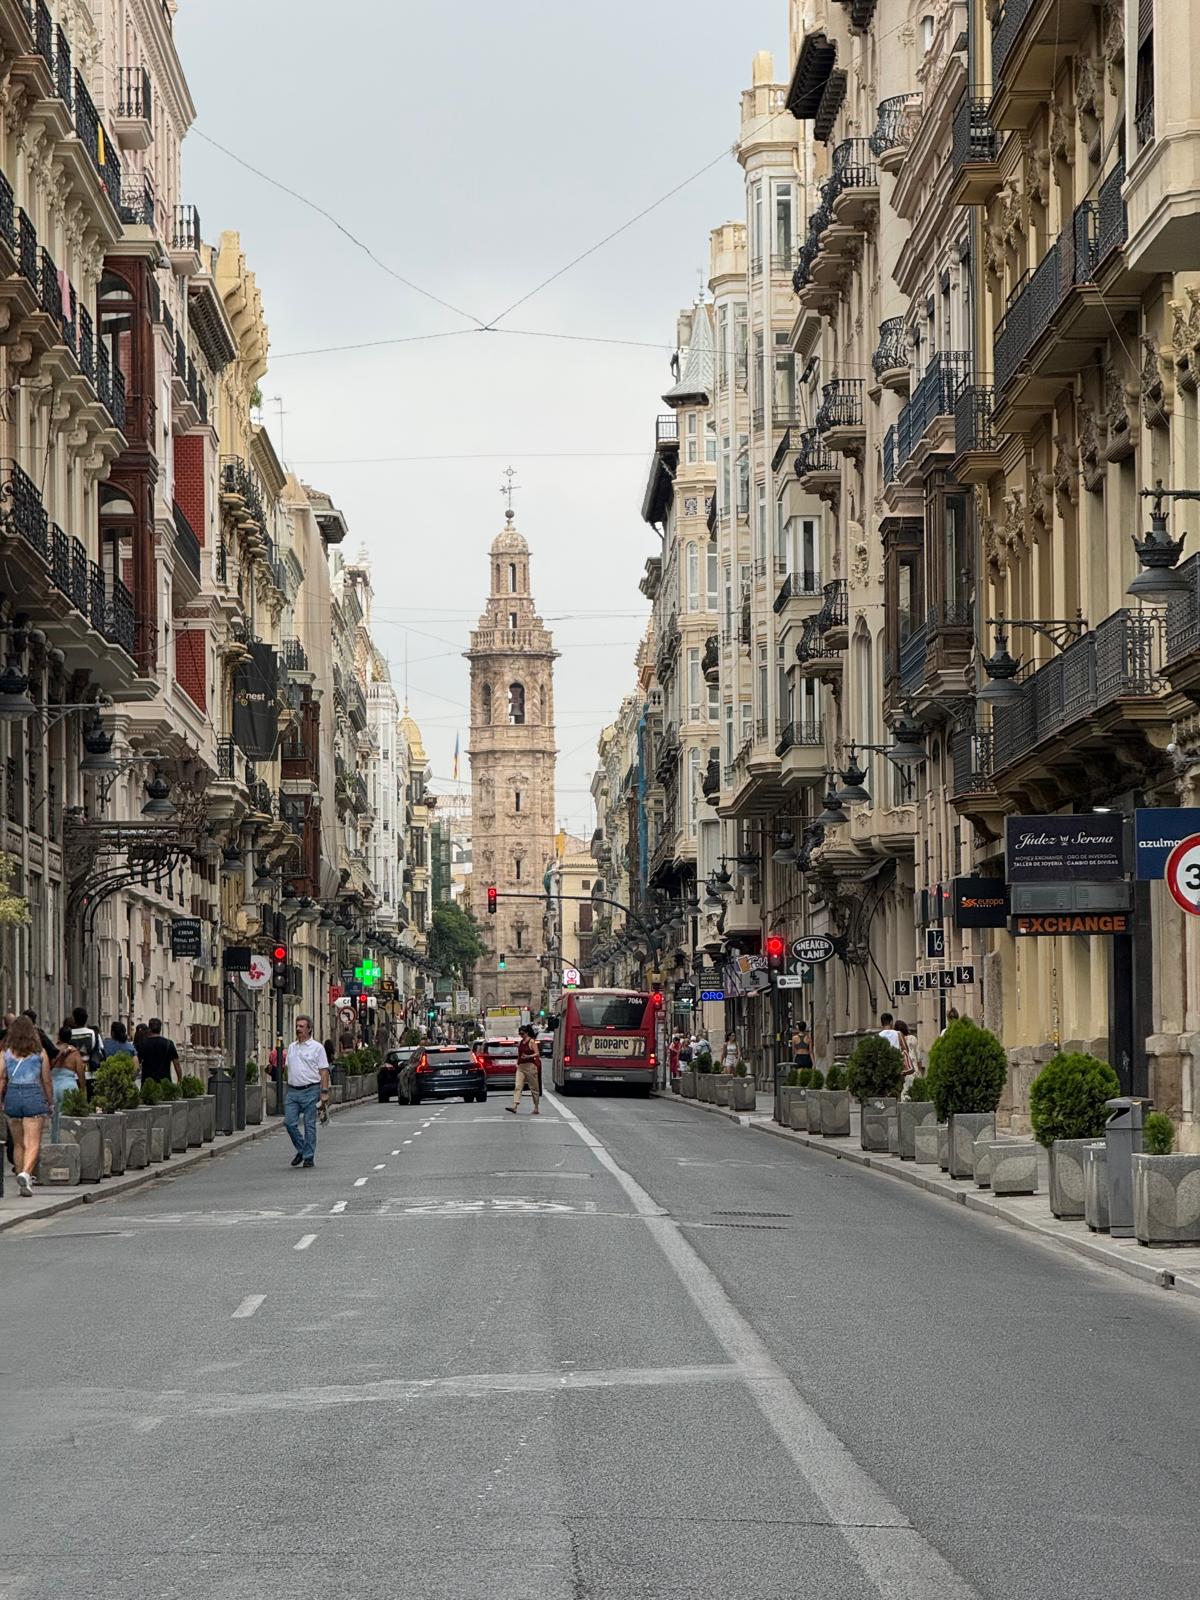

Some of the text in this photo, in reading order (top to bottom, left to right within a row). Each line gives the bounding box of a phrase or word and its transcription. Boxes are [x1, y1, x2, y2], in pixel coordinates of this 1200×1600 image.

[1015, 831, 1114, 849] Júdez Serena
[1017, 915, 1126, 932] EXCHANGE
[796, 940, 830, 951] SNEAKER
[801, 950, 826, 959] LANE
[701, 991, 724, 1000] ORO
